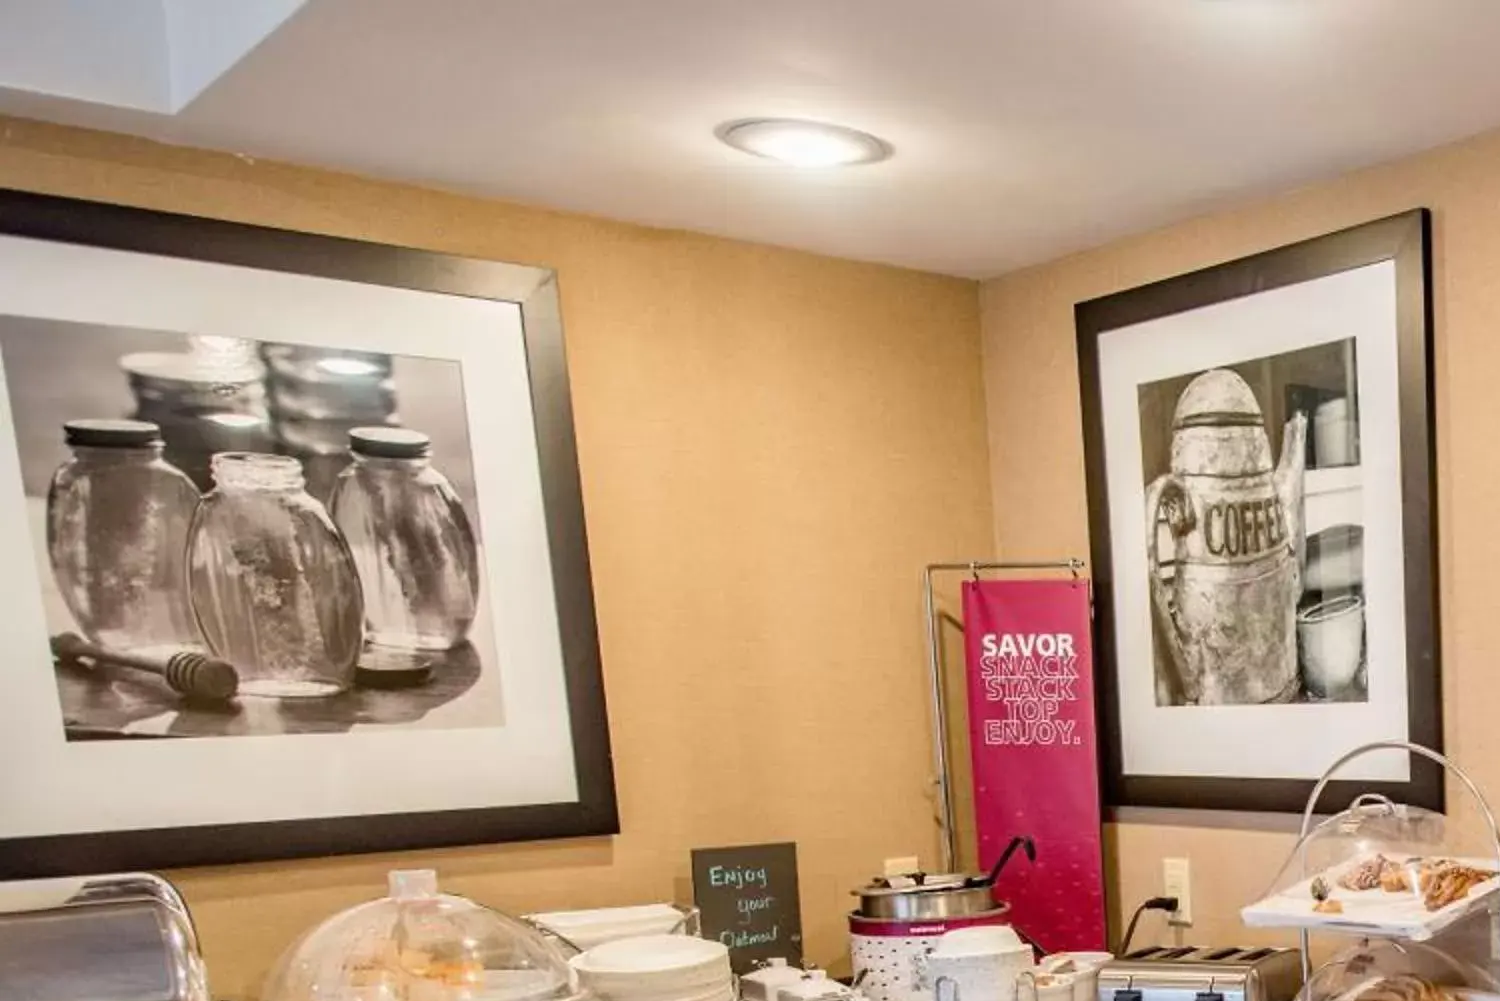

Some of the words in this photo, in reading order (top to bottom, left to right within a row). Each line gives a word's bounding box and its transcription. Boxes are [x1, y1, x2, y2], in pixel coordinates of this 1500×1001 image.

[982, 632, 1075, 657] SAVOR
[980, 654, 1079, 679] SNACK
[985, 676, 1077, 701] STACK
[1003, 697, 1060, 722] TOP
[984, 719, 1081, 745] ENJOY.
[737, 895, 777, 925] your
